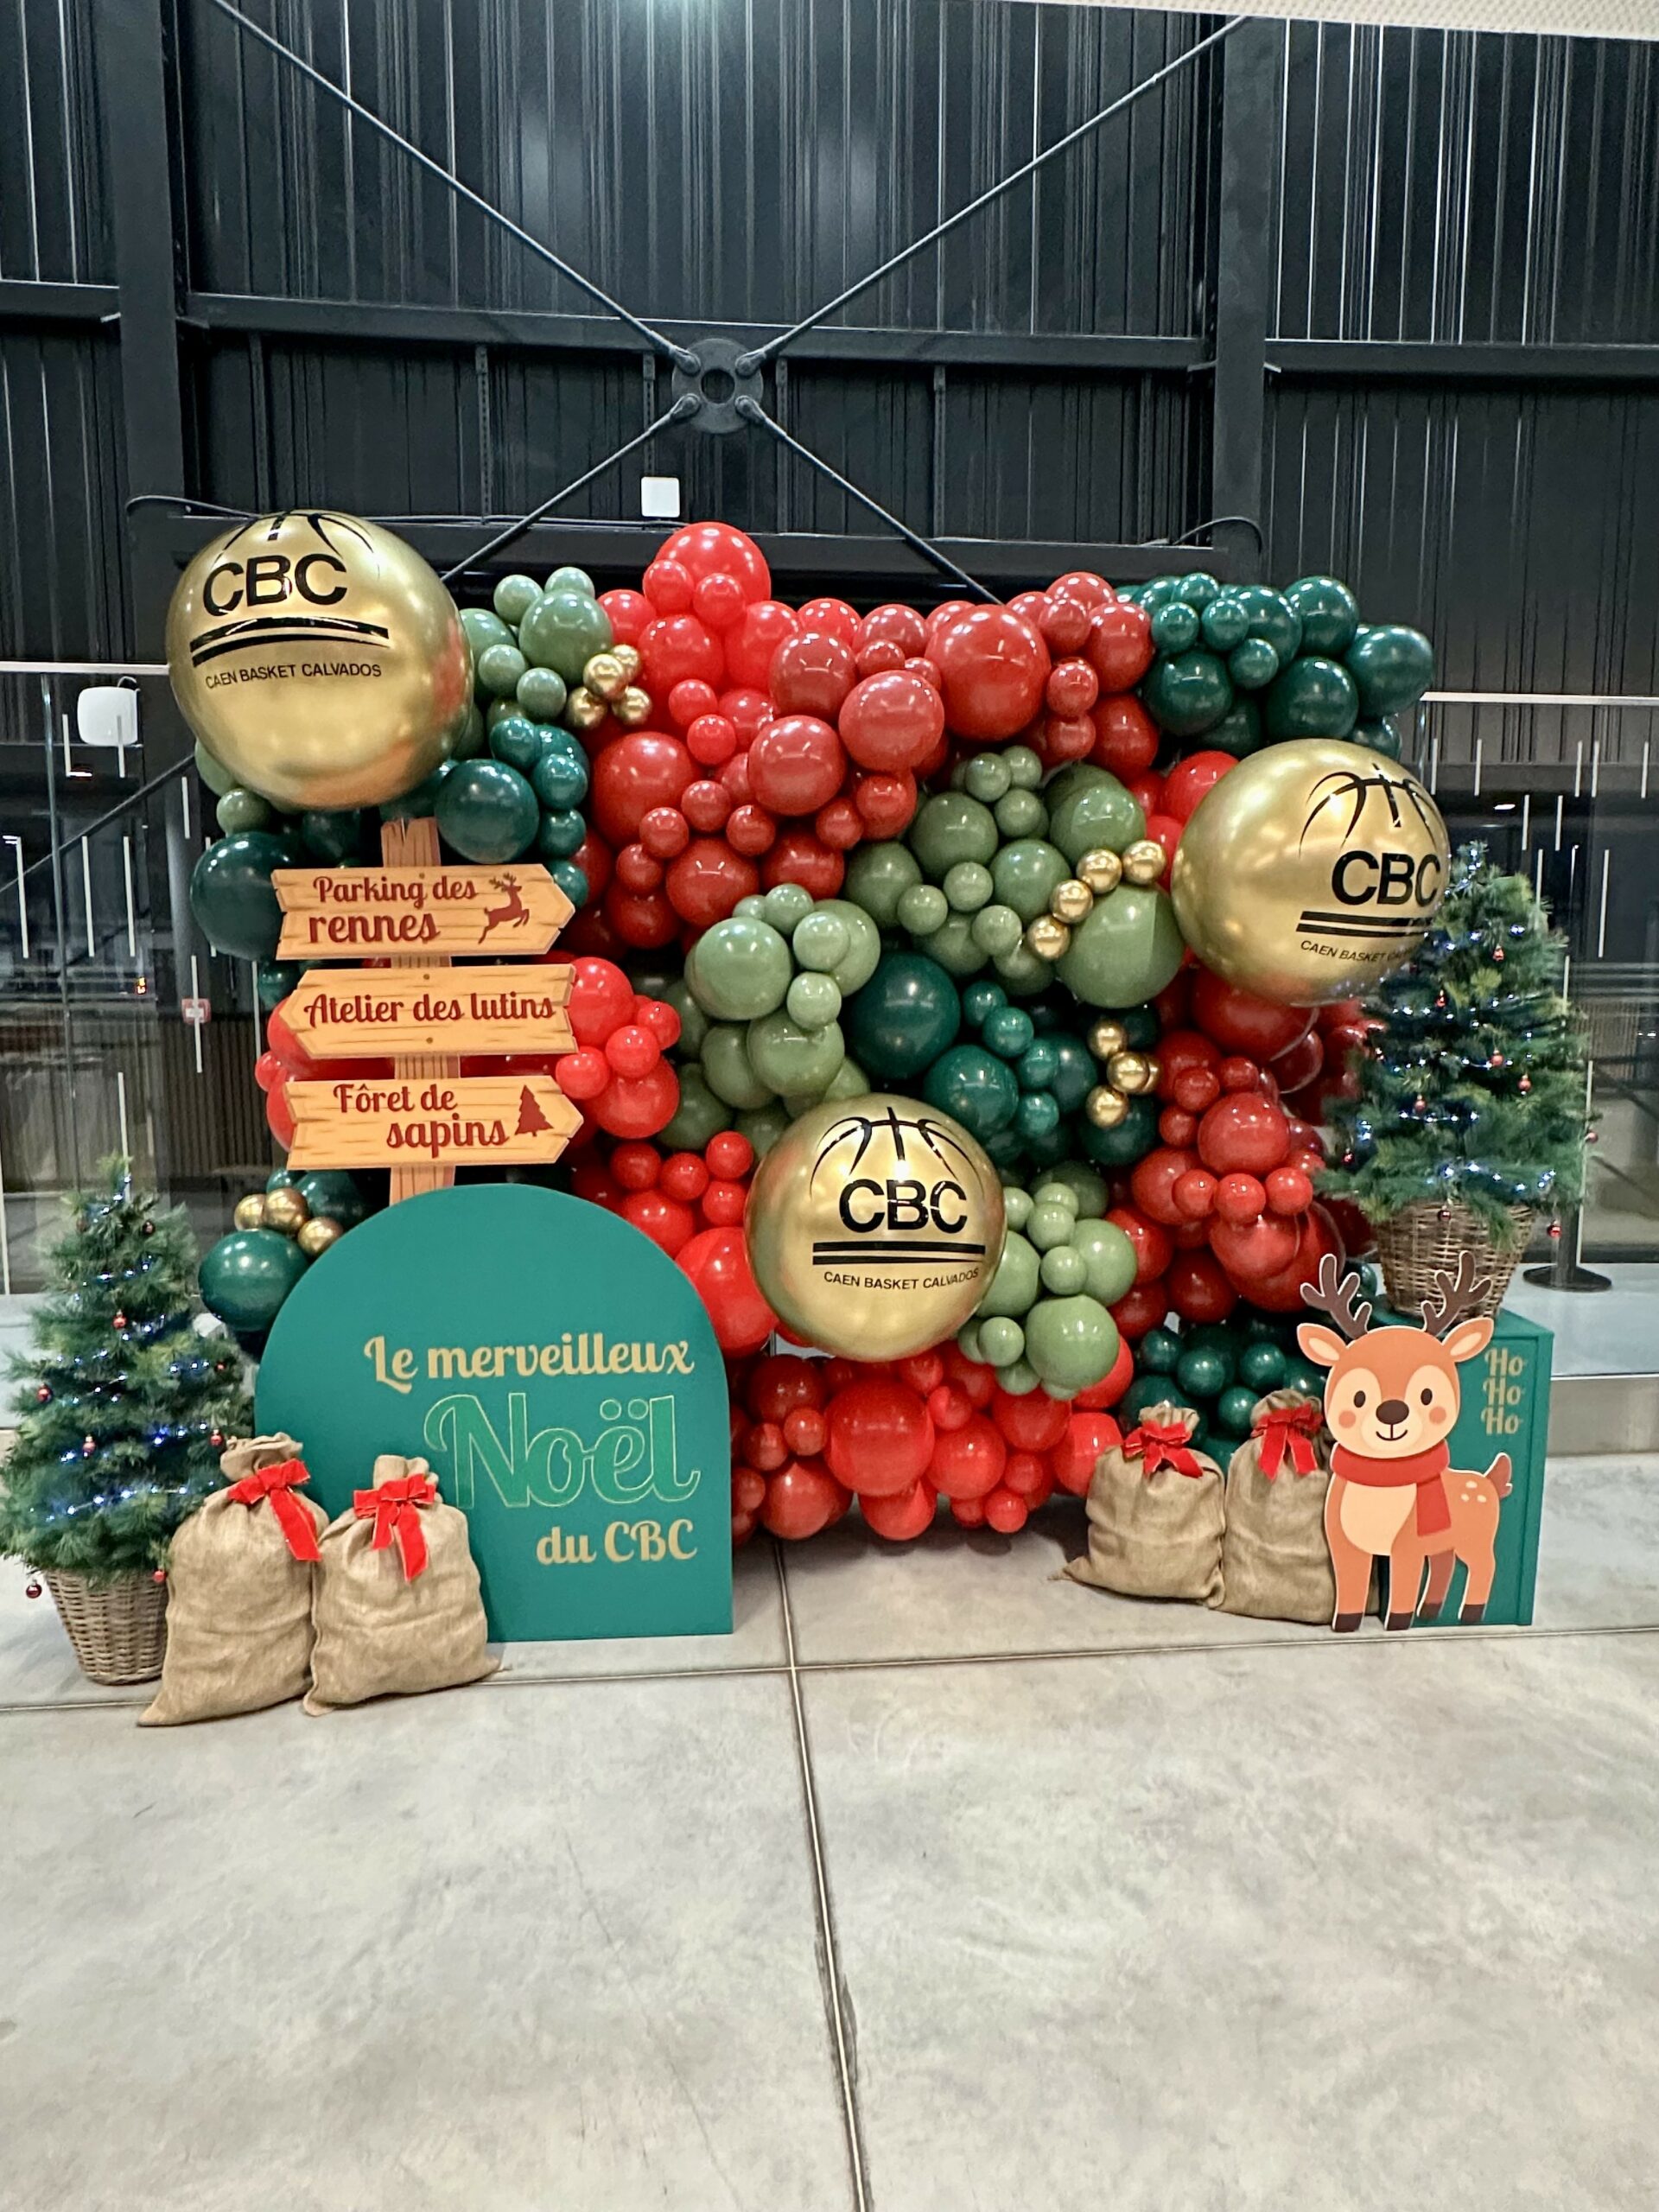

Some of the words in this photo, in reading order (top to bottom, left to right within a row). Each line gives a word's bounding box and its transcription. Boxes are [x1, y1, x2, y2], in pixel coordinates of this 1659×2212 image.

[203, 554, 348, 616] CBC
[206, 672, 238, 689] CAEN
[240, 664, 296, 681] BASKET
[302, 664, 382, 678] CALVADOS
[313, 875, 426, 908] Parking
[433, 876, 478, 900] des
[1332, 850, 1440, 907] CBC
[308, 912, 441, 944] rennes
[1300, 940, 1339, 958] CAEN
[1339, 950, 1386, 963] BASKET
[303, 994, 404, 1027] Atelier
[413, 994, 465, 1021] des
[470, 991, 556, 1020] lutins
[334, 1083, 415, 1114] Fôret
[420, 1084, 458, 1111] de
[386, 1112, 510, 1159] sapins
[839, 1179, 968, 1233] CBC
[823, 1271, 861, 1287] CAEN
[864, 1277, 919, 1290] BASKET
[923, 1268, 979, 1289] CALVADOS
[364, 1335, 418, 1394] Le
[428, 1332, 695, 1379] merveilleux
[1484, 1348, 1526, 1376] Ho
[1483, 1377, 1524, 1406] Ho
[1481, 1407, 1522, 1435] Ho
[423, 1392, 701, 1510] Noël
[536, 1526, 597, 1565] du
[604, 1518, 698, 1563] CBC
